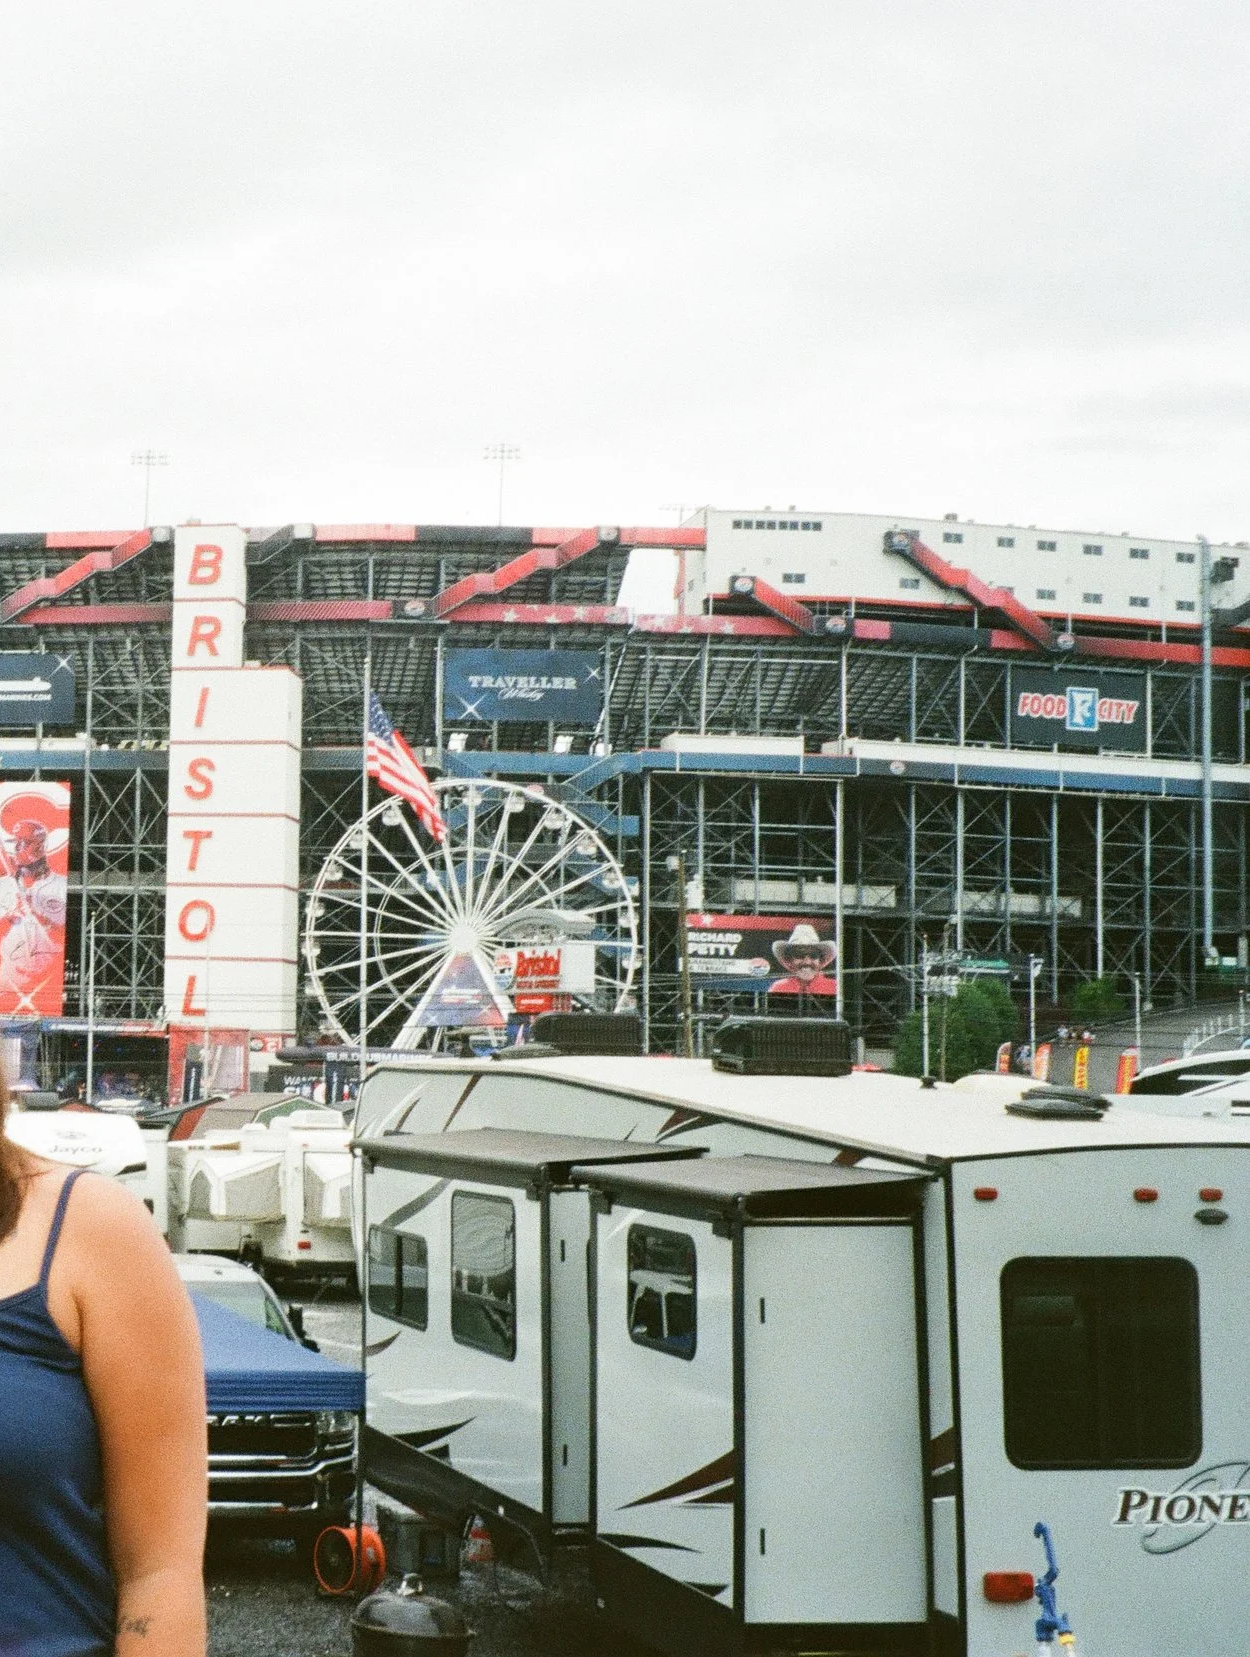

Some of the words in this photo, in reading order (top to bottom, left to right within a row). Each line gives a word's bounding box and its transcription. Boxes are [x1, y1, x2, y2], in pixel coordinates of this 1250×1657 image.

[468, 675, 578, 690] TRAVELLER
[1018, 692, 1068, 719] FOOD
[1097, 697, 1140, 723] CITY
[178, 543, 223, 1017] BRISTOL
[687, 942, 739, 957] PETTY
[516, 947, 562, 977] Bristol
[53, 1145, 103, 1155] Jayco
